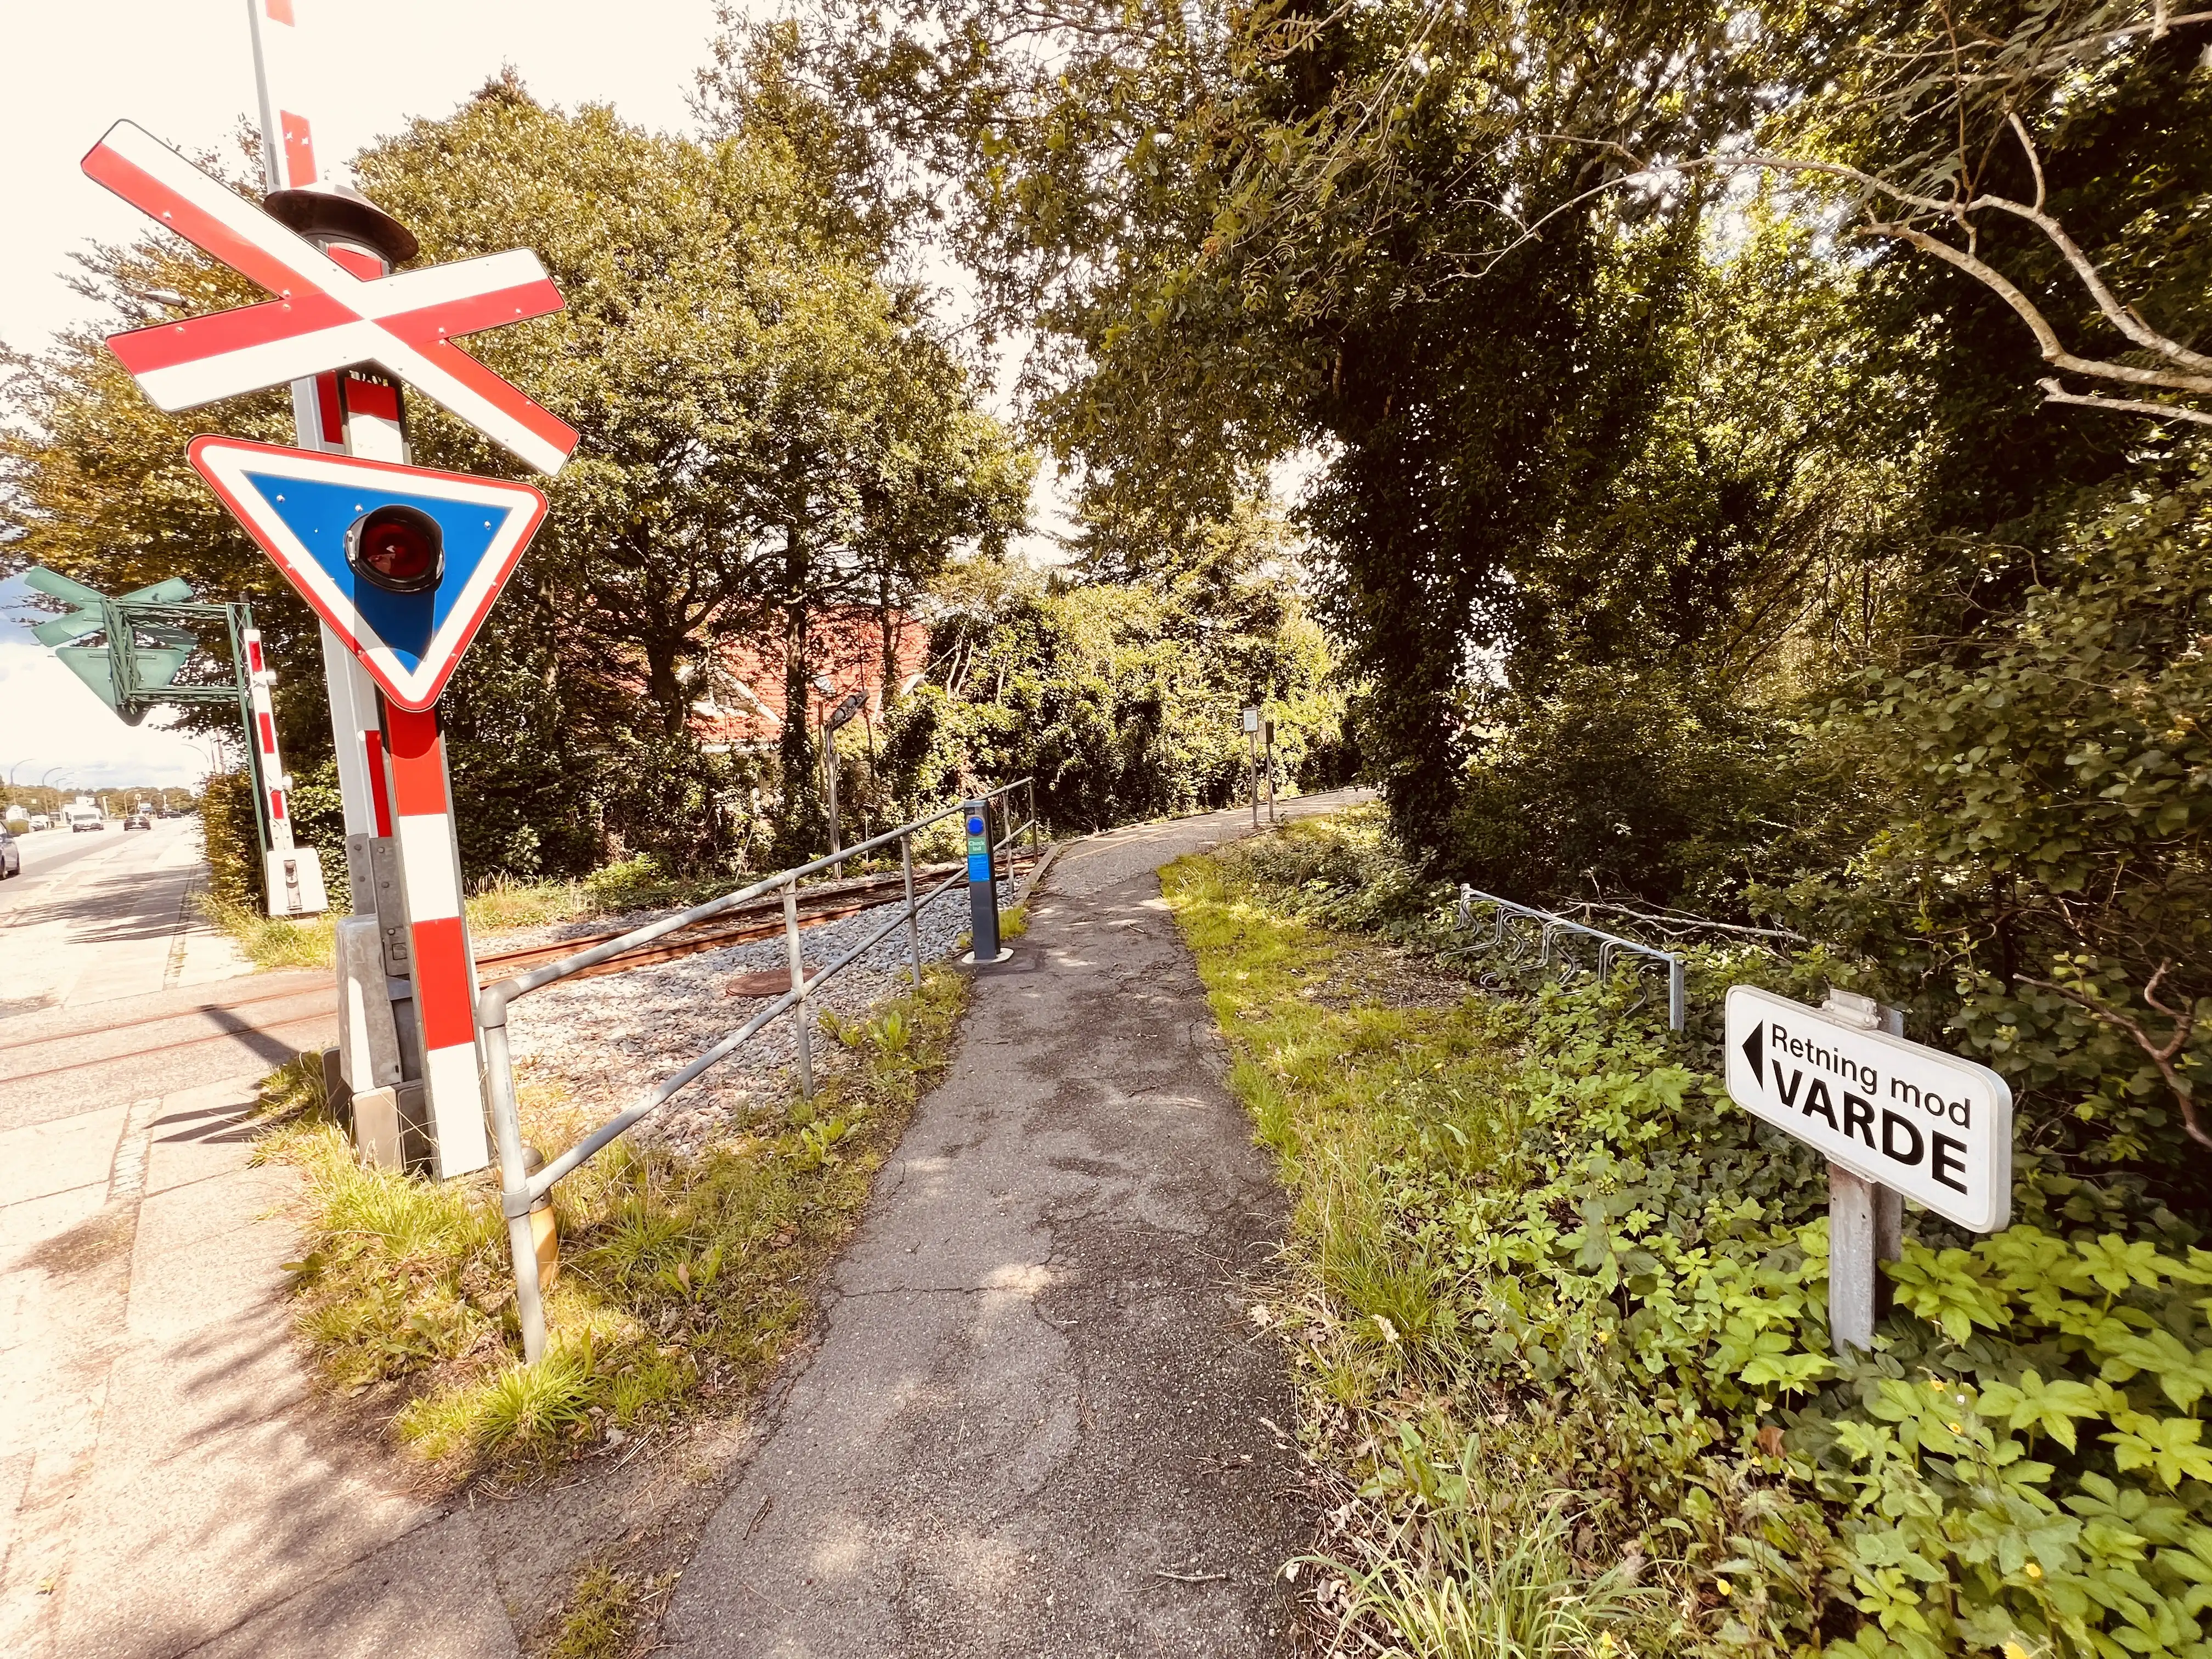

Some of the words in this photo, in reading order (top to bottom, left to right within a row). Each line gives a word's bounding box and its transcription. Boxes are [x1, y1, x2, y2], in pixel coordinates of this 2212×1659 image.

[1771, 1023, 1877, 1096] Retning
[1891, 1077, 1971, 1130] mod
[1771, 1058, 1968, 1195] VARDE
